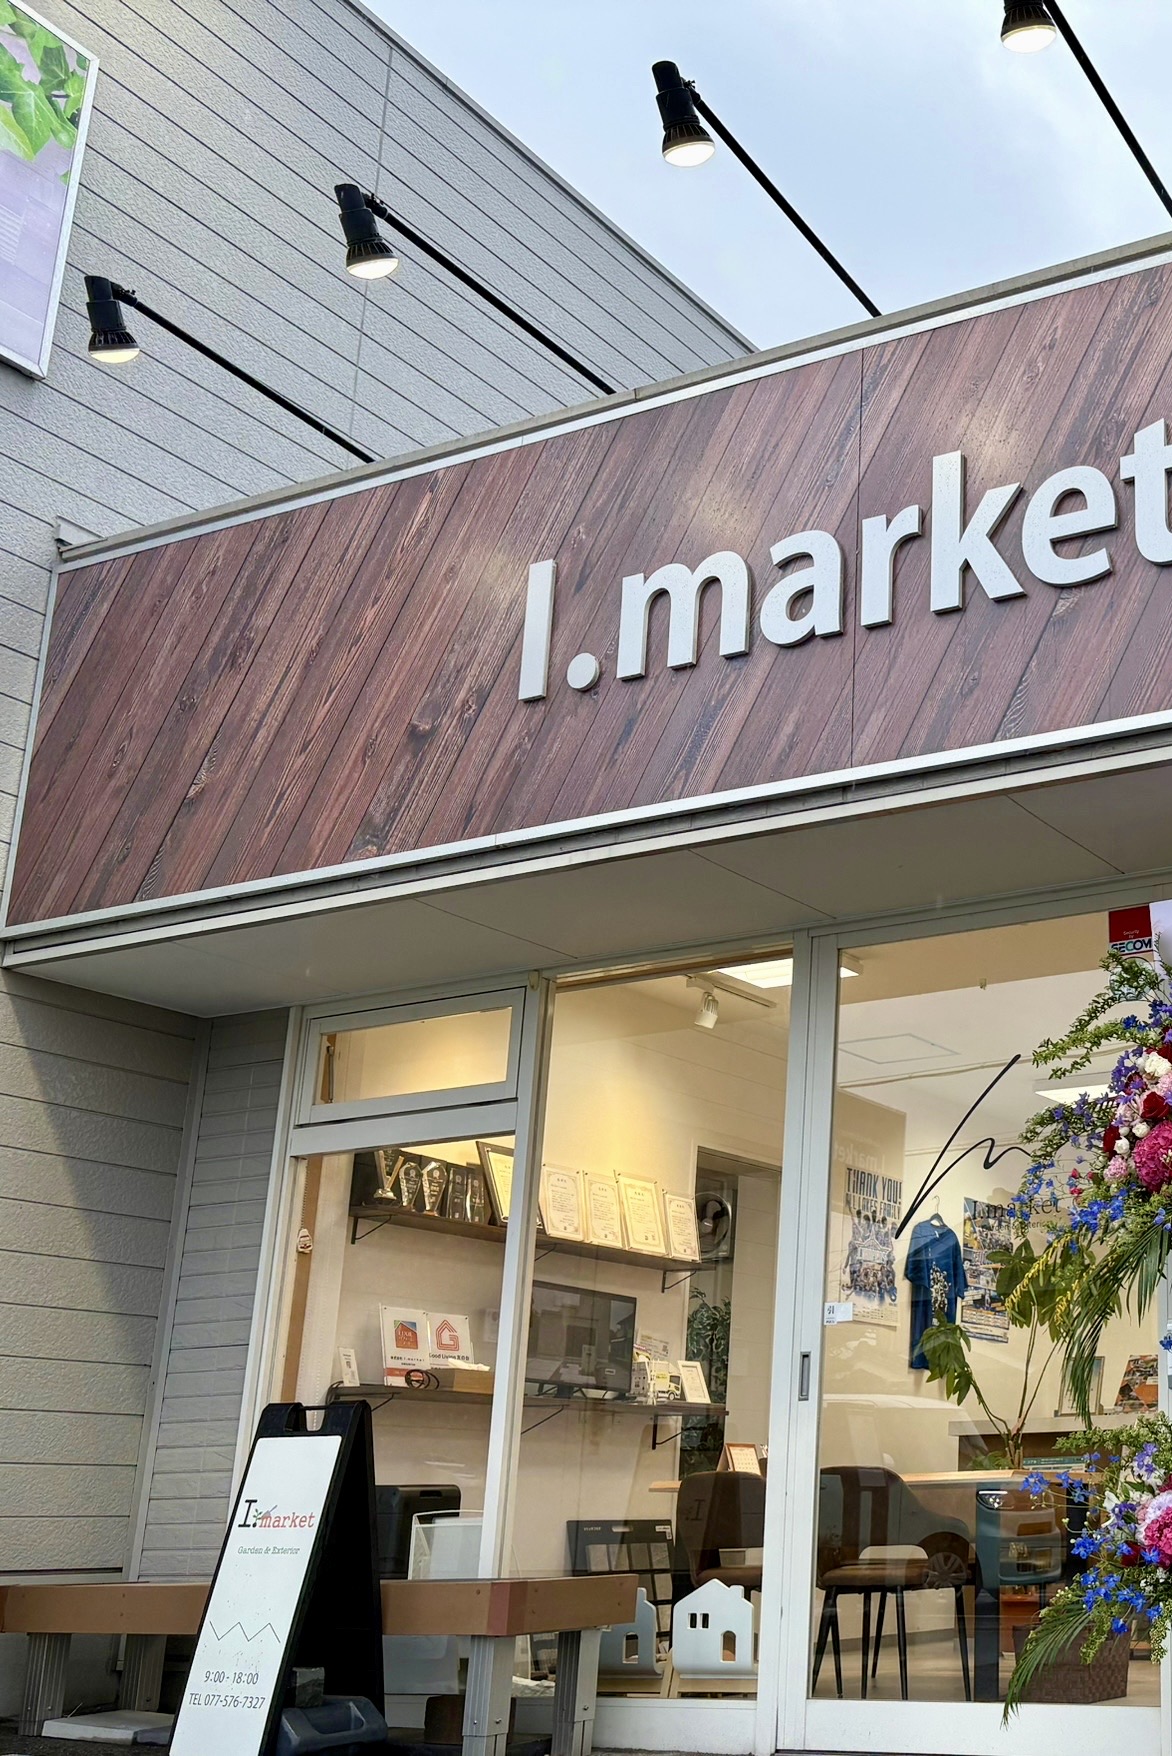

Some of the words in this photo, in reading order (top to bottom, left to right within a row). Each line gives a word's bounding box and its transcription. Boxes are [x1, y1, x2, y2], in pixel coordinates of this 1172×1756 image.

[847, 1168, 879, 1199] THANK
[882, 1176, 902, 1206] YOU!
[238, 1546, 263, 1554] Garden
[271, 1546, 300, 1554] Exterior
[188, 1692, 202, 1706] TEL
[204, 1693, 266, 1709] 077-576-7327
